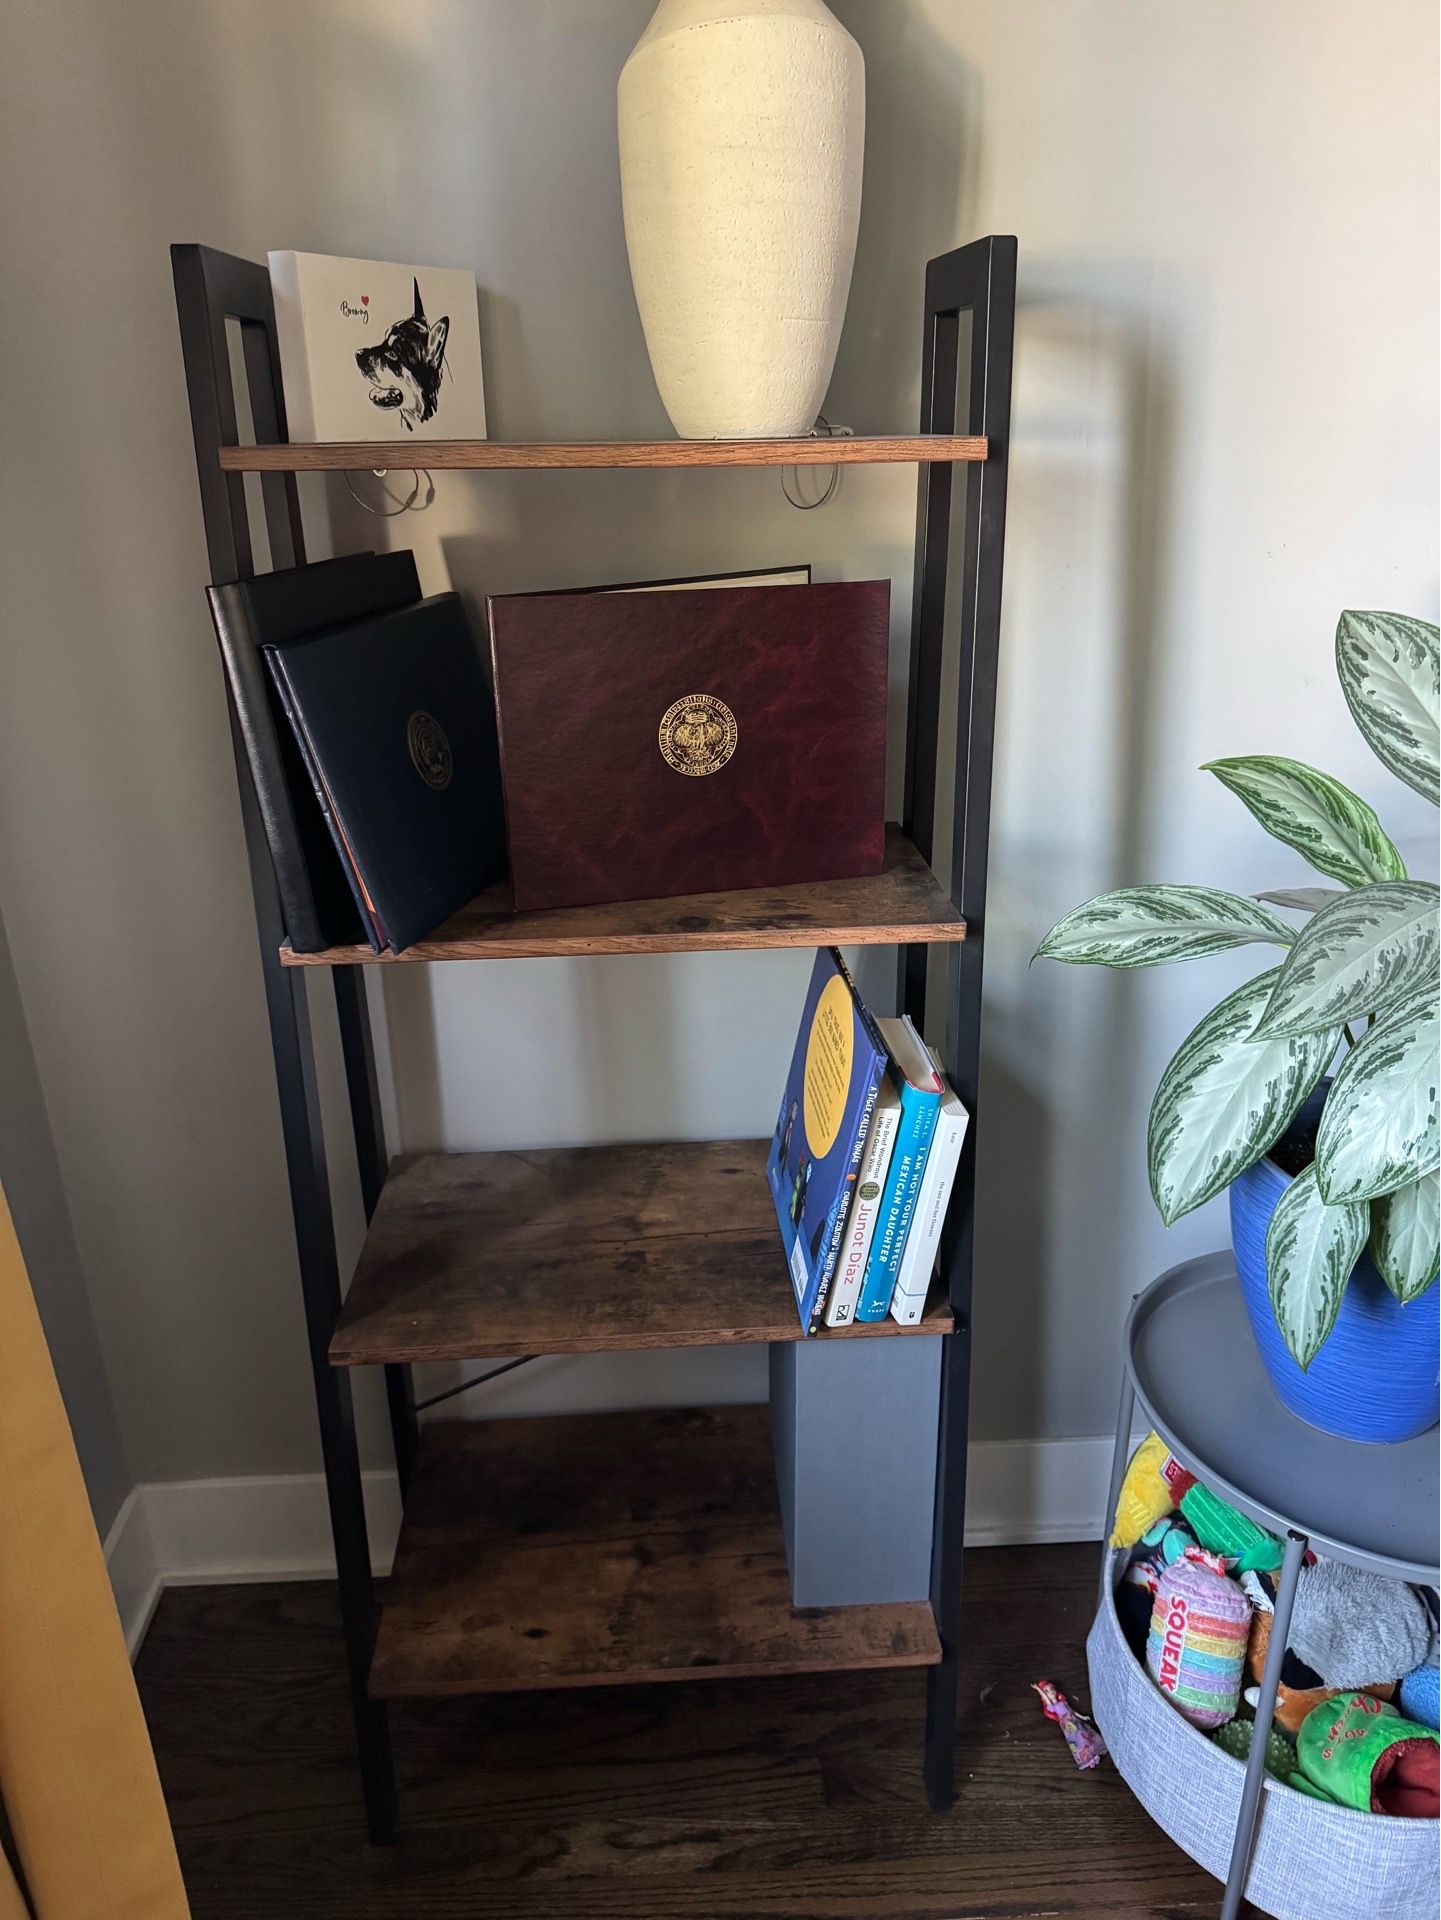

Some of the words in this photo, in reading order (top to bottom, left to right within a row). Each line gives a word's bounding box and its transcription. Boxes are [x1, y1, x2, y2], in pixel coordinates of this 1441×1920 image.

[865, 1092, 878, 1112] TIGER
[858, 1113, 870, 1139] CALLED
[877, 1116, 885, 1129] Life
[884, 1117, 893, 1130] The
[924, 1108, 934, 1130] ERIKA
[870, 1138, 880, 1158] Oscar
[882, 1130, 890, 1146] Brief
[867, 1158, 875, 1173] Wao
[873, 1146, 886, 1179] Wondrous
[914, 1155, 924, 1170] AM
[893, 1155, 911, 1205] MEXICAN
[908, 1174, 919, 1194] NOT
[837, 1190, 851, 1220] CHARLOTTE
[900, 1198, 913, 1226] YOUR
[852, 1203, 872, 1248] Junot
[879, 1207, 899, 1263] DAUGHTER
[888, 1229, 905, 1272] PERFECT
[843, 1252, 862, 1285] Díaz
[1159, 1594, 1188, 1693] SQUEAK
